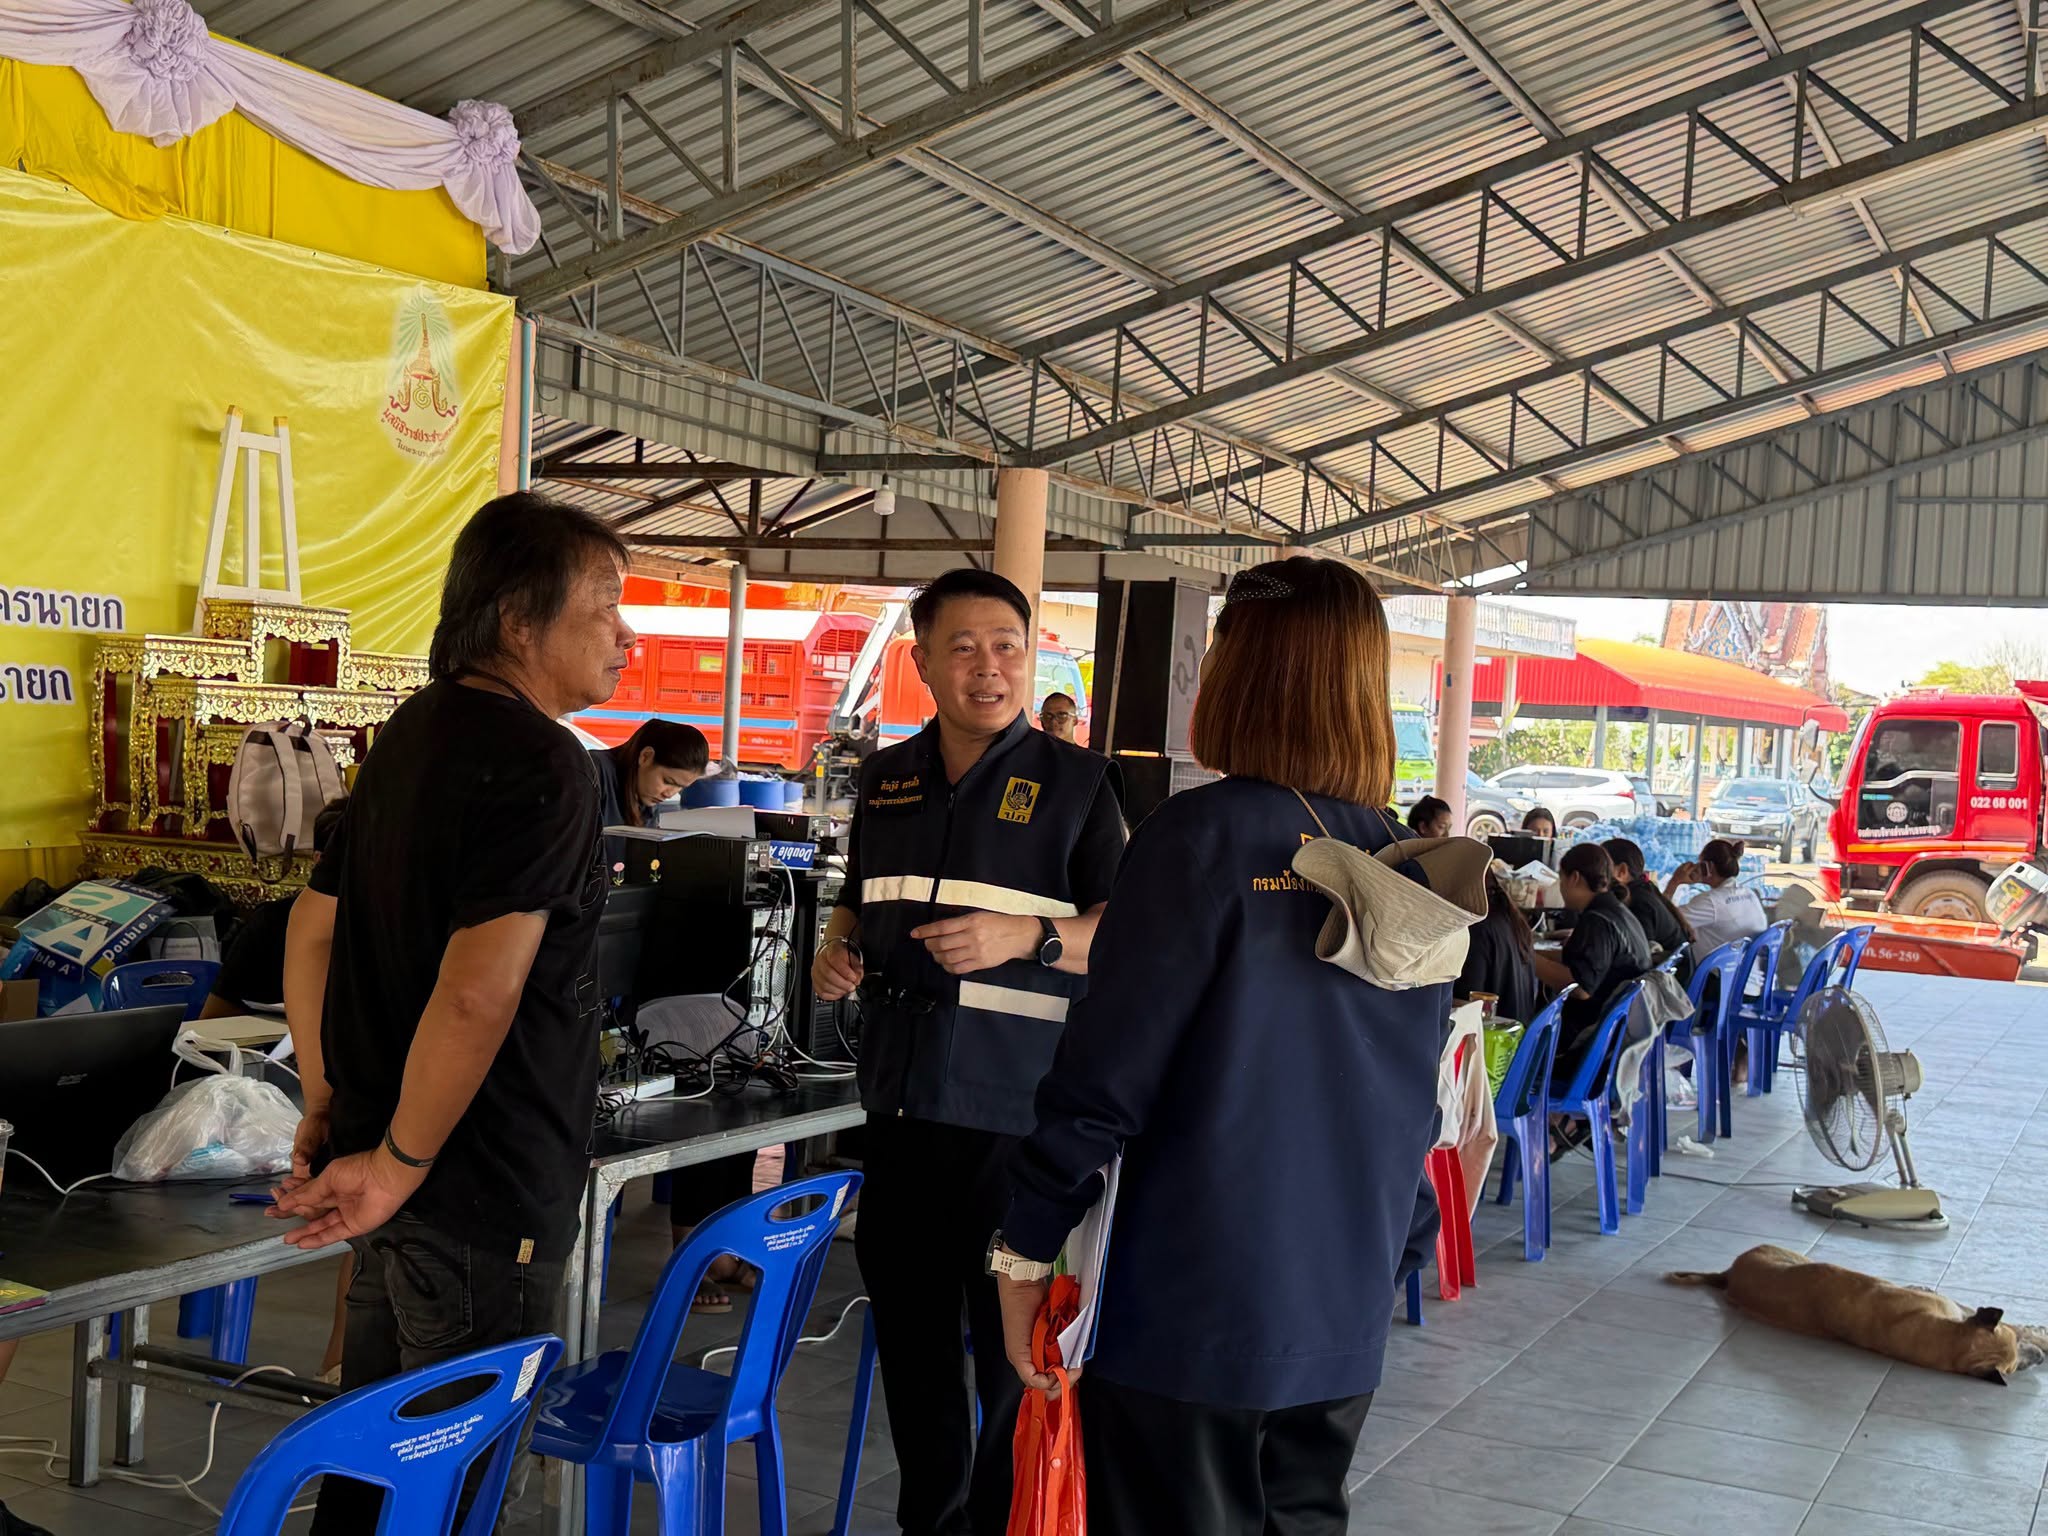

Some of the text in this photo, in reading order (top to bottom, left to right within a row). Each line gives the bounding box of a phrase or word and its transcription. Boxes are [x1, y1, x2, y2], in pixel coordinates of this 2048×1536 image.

[0, 667, 72, 701] ายก
[1970, 796, 1991, 809] 022
[2008, 797, 2028, 810] 001
[769, 845, 813, 862] Double A
[59, 905, 97, 921] Double
[102, 913, 160, 961] Double A
